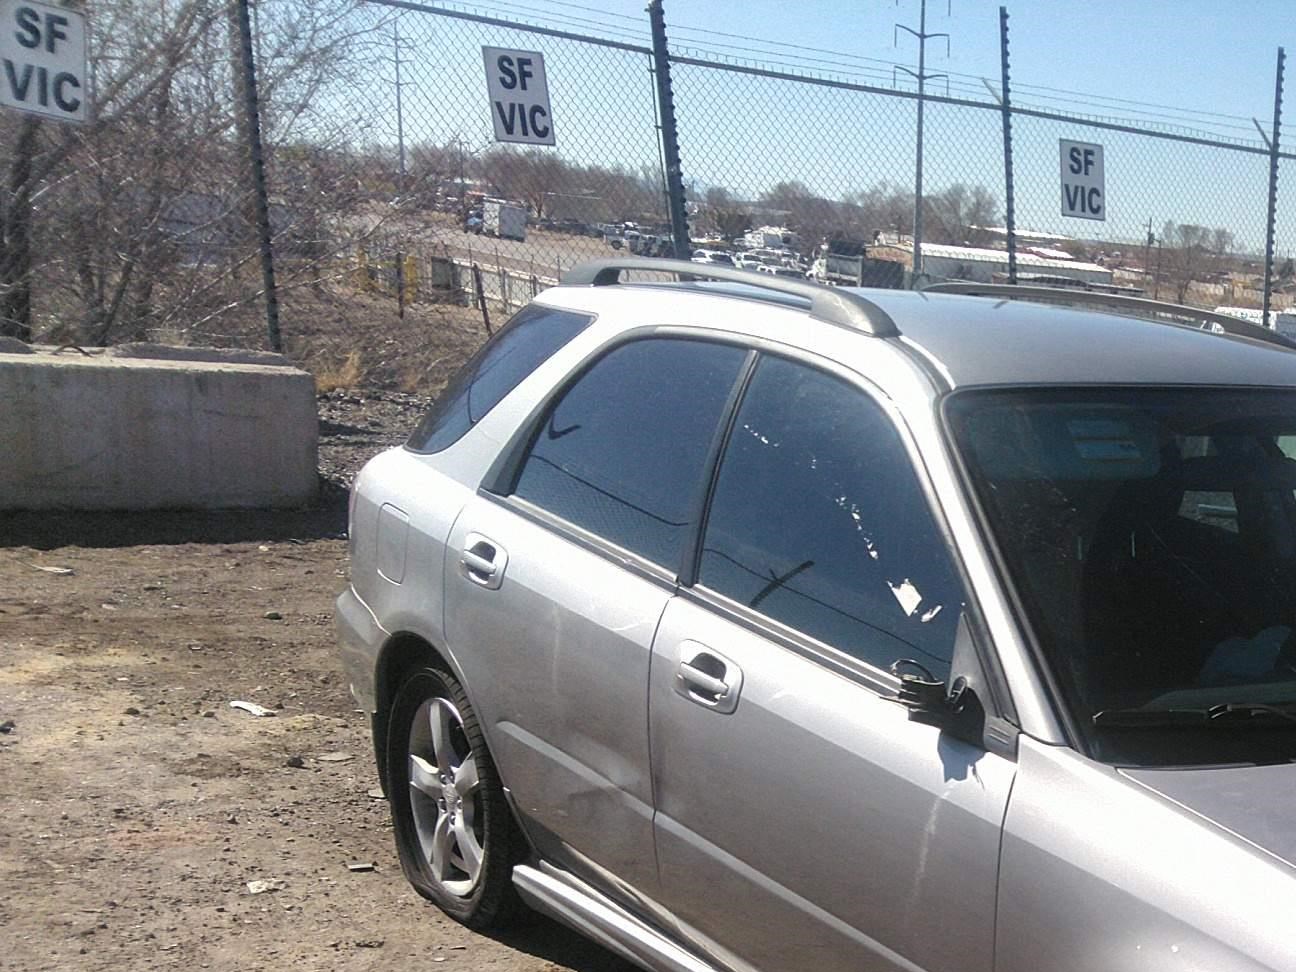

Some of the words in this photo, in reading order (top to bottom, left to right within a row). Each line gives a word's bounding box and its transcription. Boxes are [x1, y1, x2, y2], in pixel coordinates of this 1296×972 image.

[15, 7, 68, 54] SF
[3, 58, 80, 113] VIC
[497, 55, 532, 91] SF
[495, 101, 549, 138] VIC
[1069, 146, 1094, 176] SF
[1064, 183, 1102, 215] VIC
